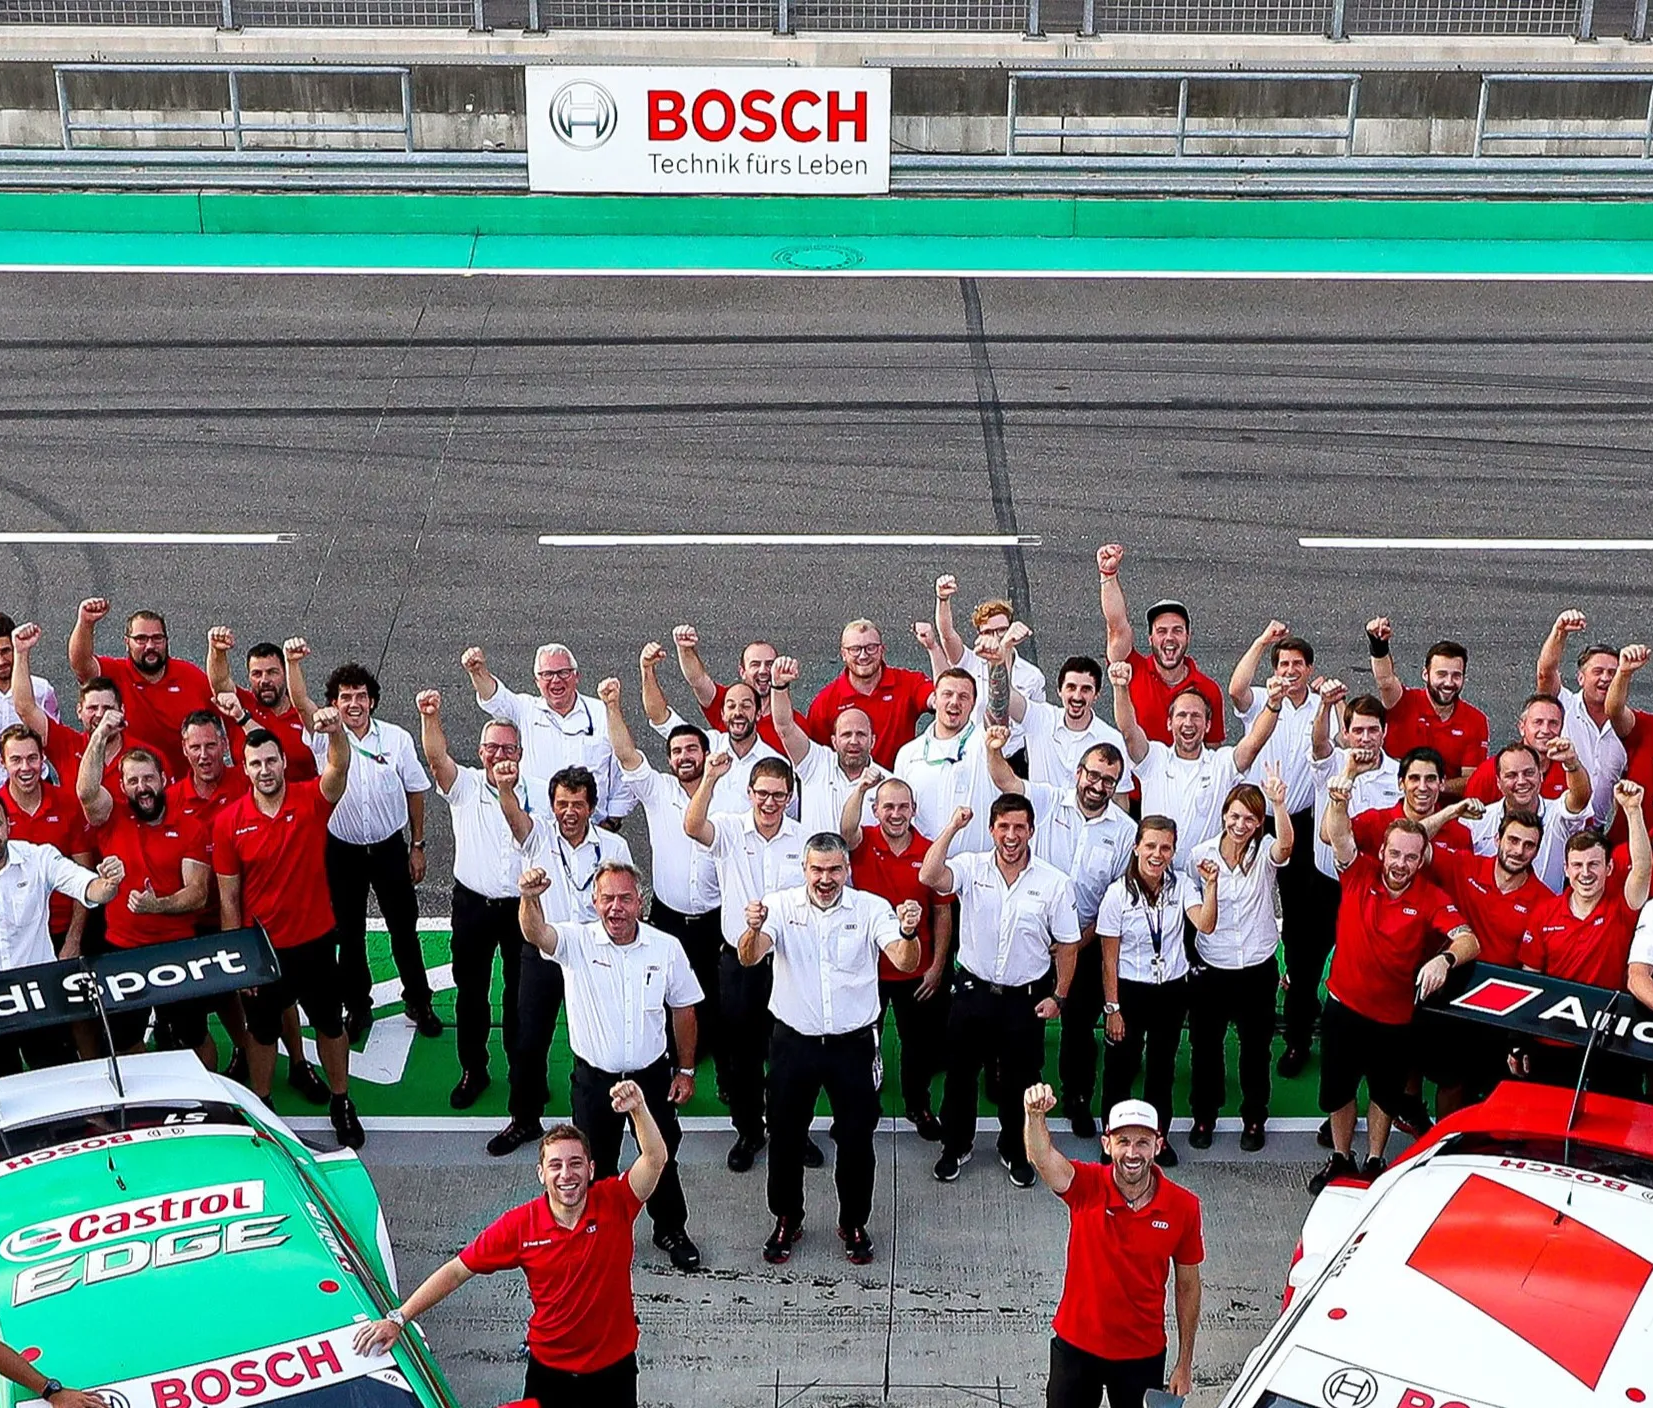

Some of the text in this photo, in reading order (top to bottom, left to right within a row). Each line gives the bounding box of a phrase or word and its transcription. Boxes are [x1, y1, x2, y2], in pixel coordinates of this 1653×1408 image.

[647, 89, 868, 142] BOSCH
[648, 153, 868, 176] Technik fürs Leben
[61, 948, 247, 1004] Sport
[5, 1133, 133, 1170] BOSCH
[1500, 1158, 1628, 1192] BOSCH
[69, 1187, 250, 1243] Castrol
[12, 1214, 292, 1308] EDGE
